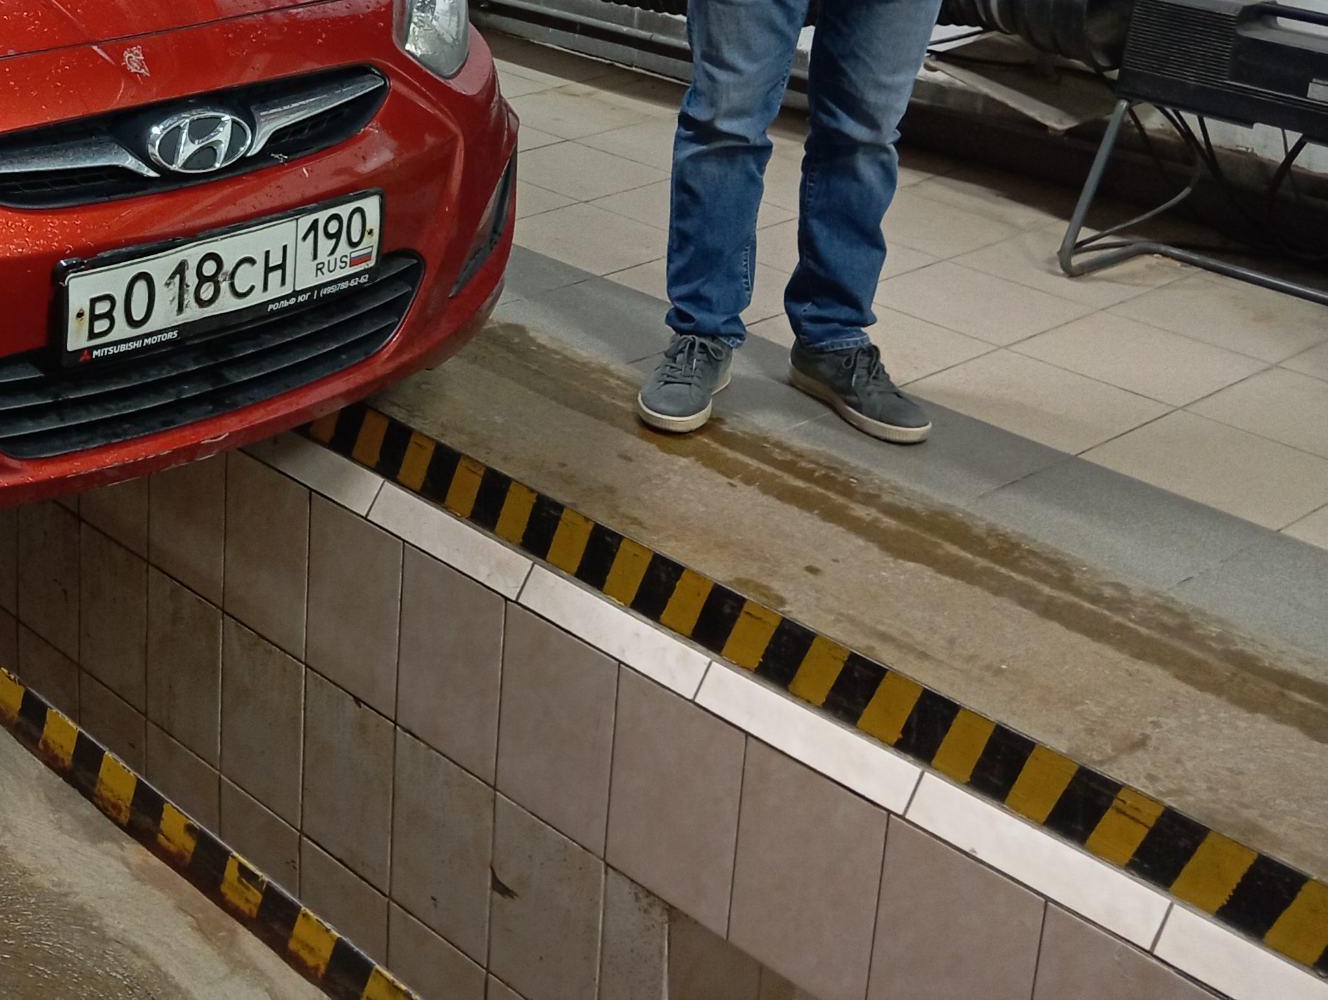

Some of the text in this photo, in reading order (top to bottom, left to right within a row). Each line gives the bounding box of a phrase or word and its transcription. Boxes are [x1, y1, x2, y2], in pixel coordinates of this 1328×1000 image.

[86, 206, 368, 342] В018СН 190
[314, 254, 348, 279] RUS
[267, 297, 297, 312] РОЛЬФ
[297, 292, 312, 303] ЮГ
[92, 330, 179, 359] MITSUBISHI MOTORS
